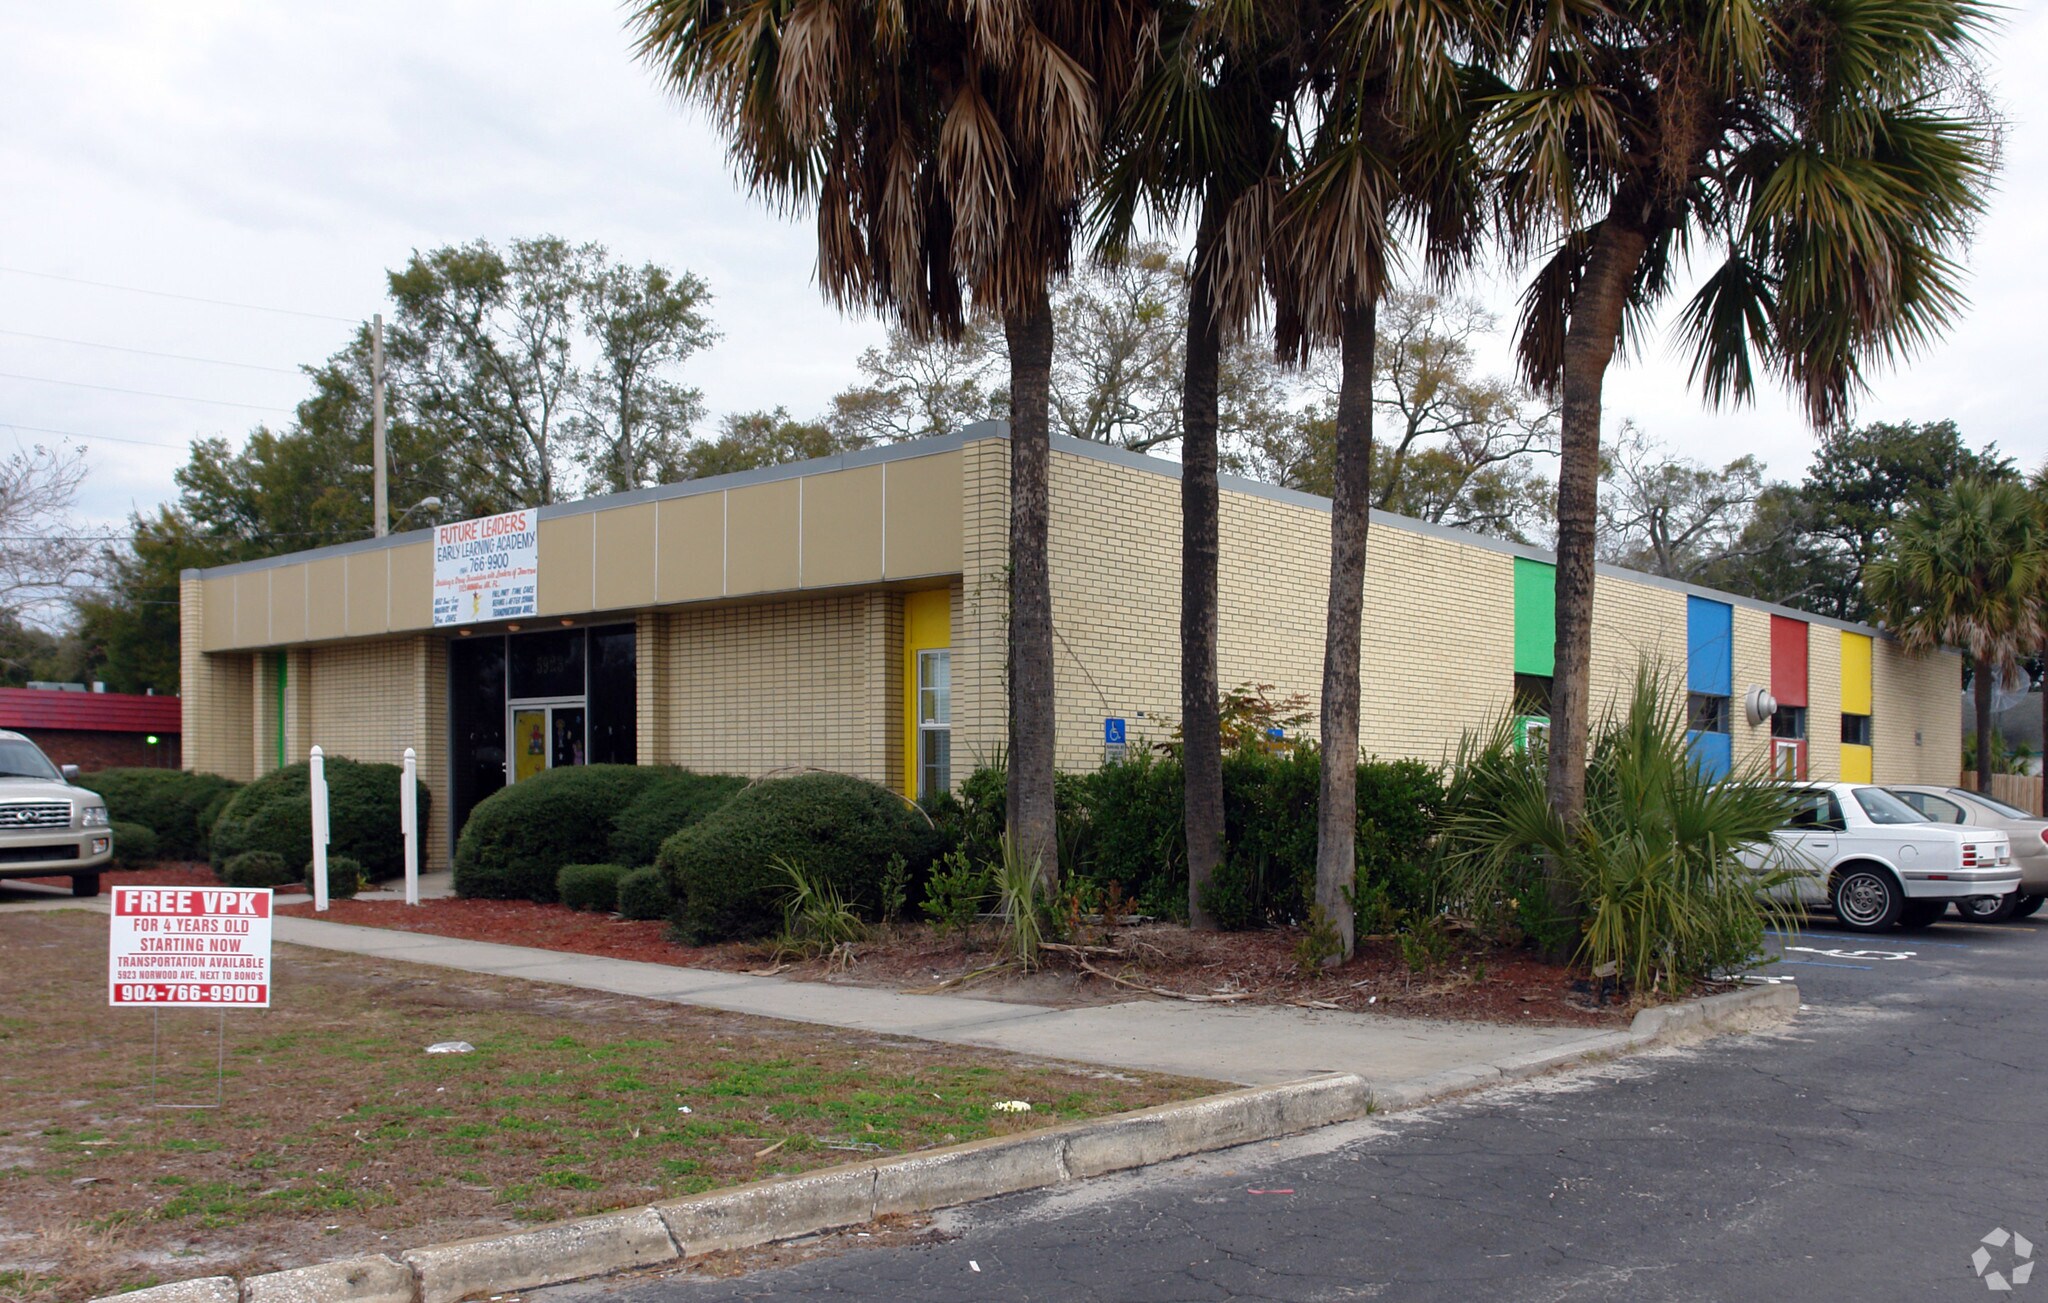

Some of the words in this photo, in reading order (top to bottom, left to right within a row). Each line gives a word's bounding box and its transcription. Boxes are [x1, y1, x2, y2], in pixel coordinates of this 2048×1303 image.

[440, 522, 477, 545] FUTURE
[481, 512, 526, 538] LEADERS
[437, 544, 460, 562] EARLY
[462, 538, 495, 558] LEARNING
[496, 531, 535, 551] ACADEMY
[469, 552, 509, 573] 766-9900
[124, 890, 192, 913] FREE
[202, 892, 257, 914] VPK
[133, 918, 158, 932] FOR
[163, 919, 171, 931] 4
[177, 919, 218, 932] YEARS
[224, 919, 249, 933] OLD
[140, 938, 204, 952] STARTING
[209, 939, 241, 952] NOW
[117, 956, 205, 967] TRANSPORTATION
[209, 957, 264, 968] AVAILABLE
[117, 971, 136, 980] 5923
[139, 971, 177, 980] NORWOOD
[200, 971, 219, 980] NEXT
[222, 971, 231, 980] TO
[234, 971, 263, 981] BONO'S
[121, 984, 259, 1002] 904-766-9900
